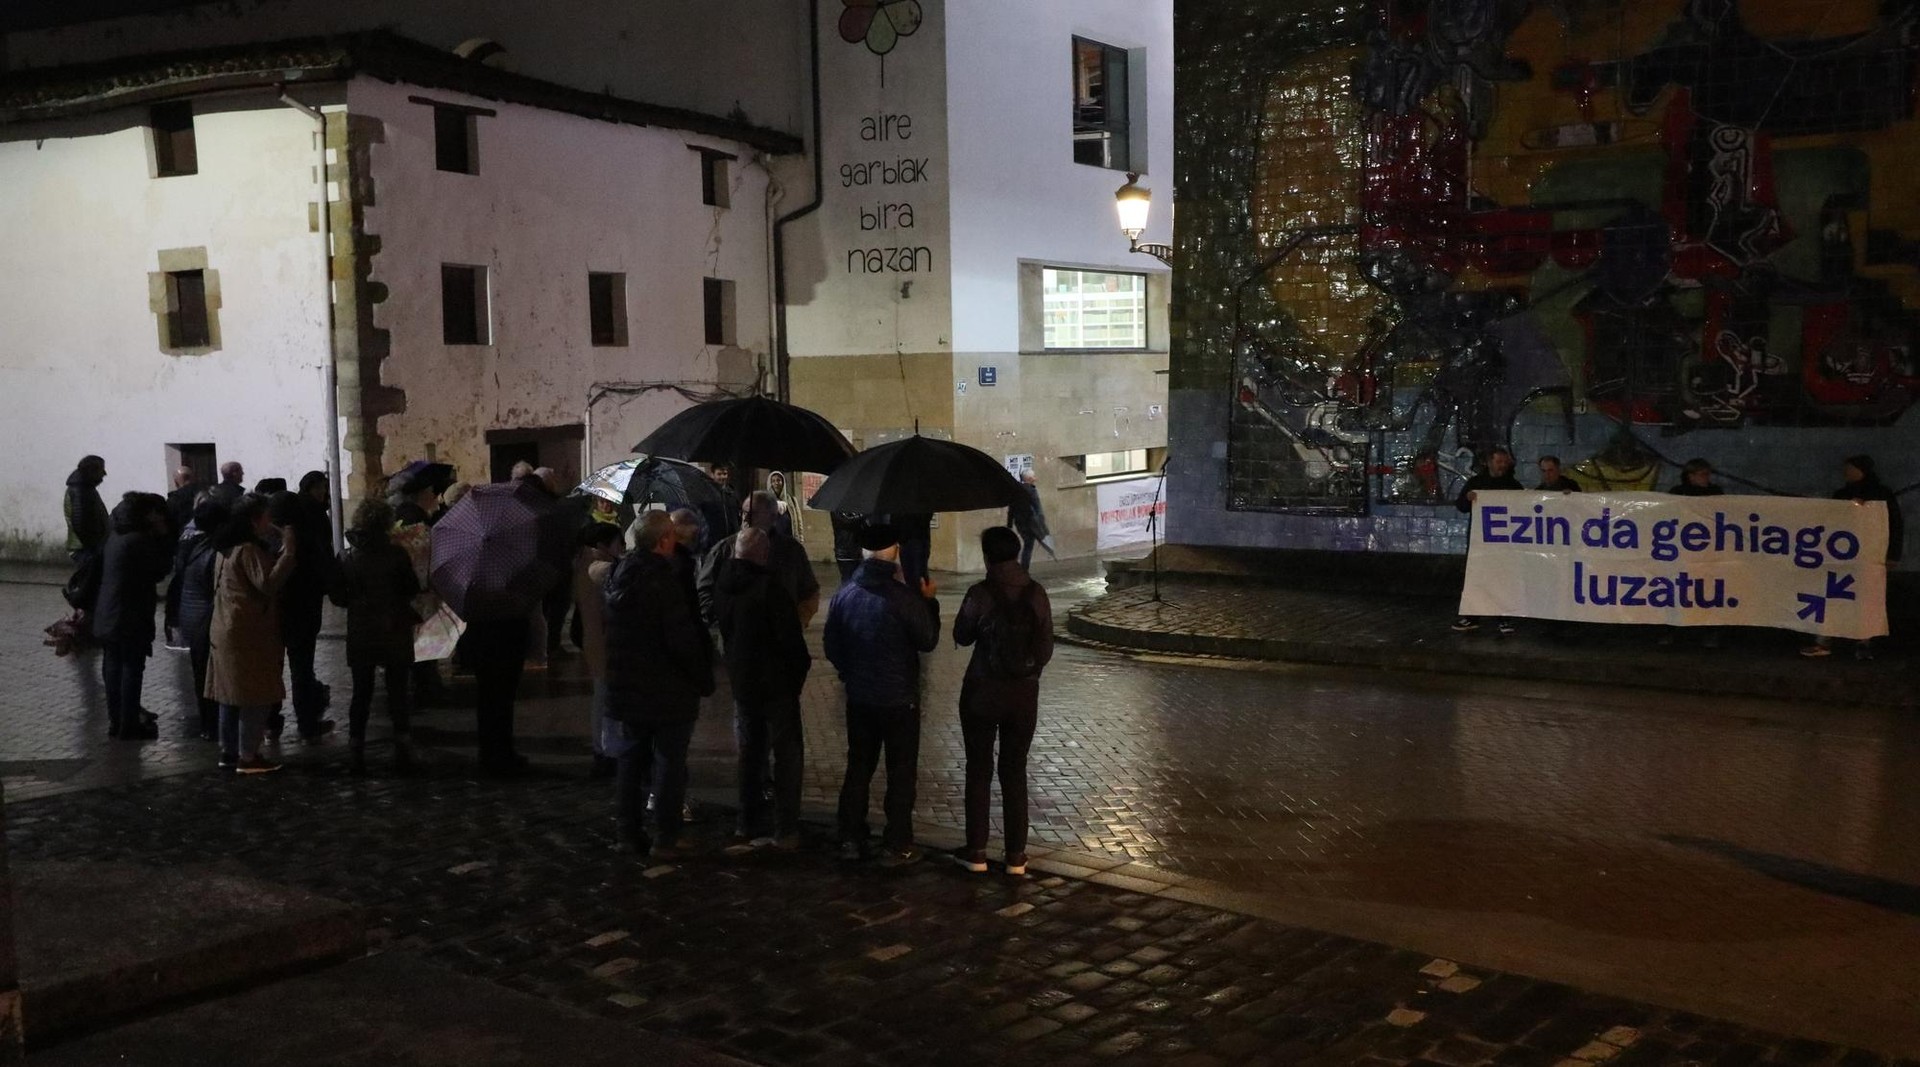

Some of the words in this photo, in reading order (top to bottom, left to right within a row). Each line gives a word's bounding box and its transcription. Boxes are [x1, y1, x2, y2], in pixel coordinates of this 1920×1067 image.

[861, 112, 912, 142] aire
[840, 156, 929, 188] garbiak
[860, 202, 915, 231] bira
[848, 247, 932, 274] nazan
[1481, 505, 1571, 545] Ezin
[1581, 508, 1639, 549] da
[1651, 512, 1860, 569] gehiago
[1574, 561, 1739, 609] luzatu.
